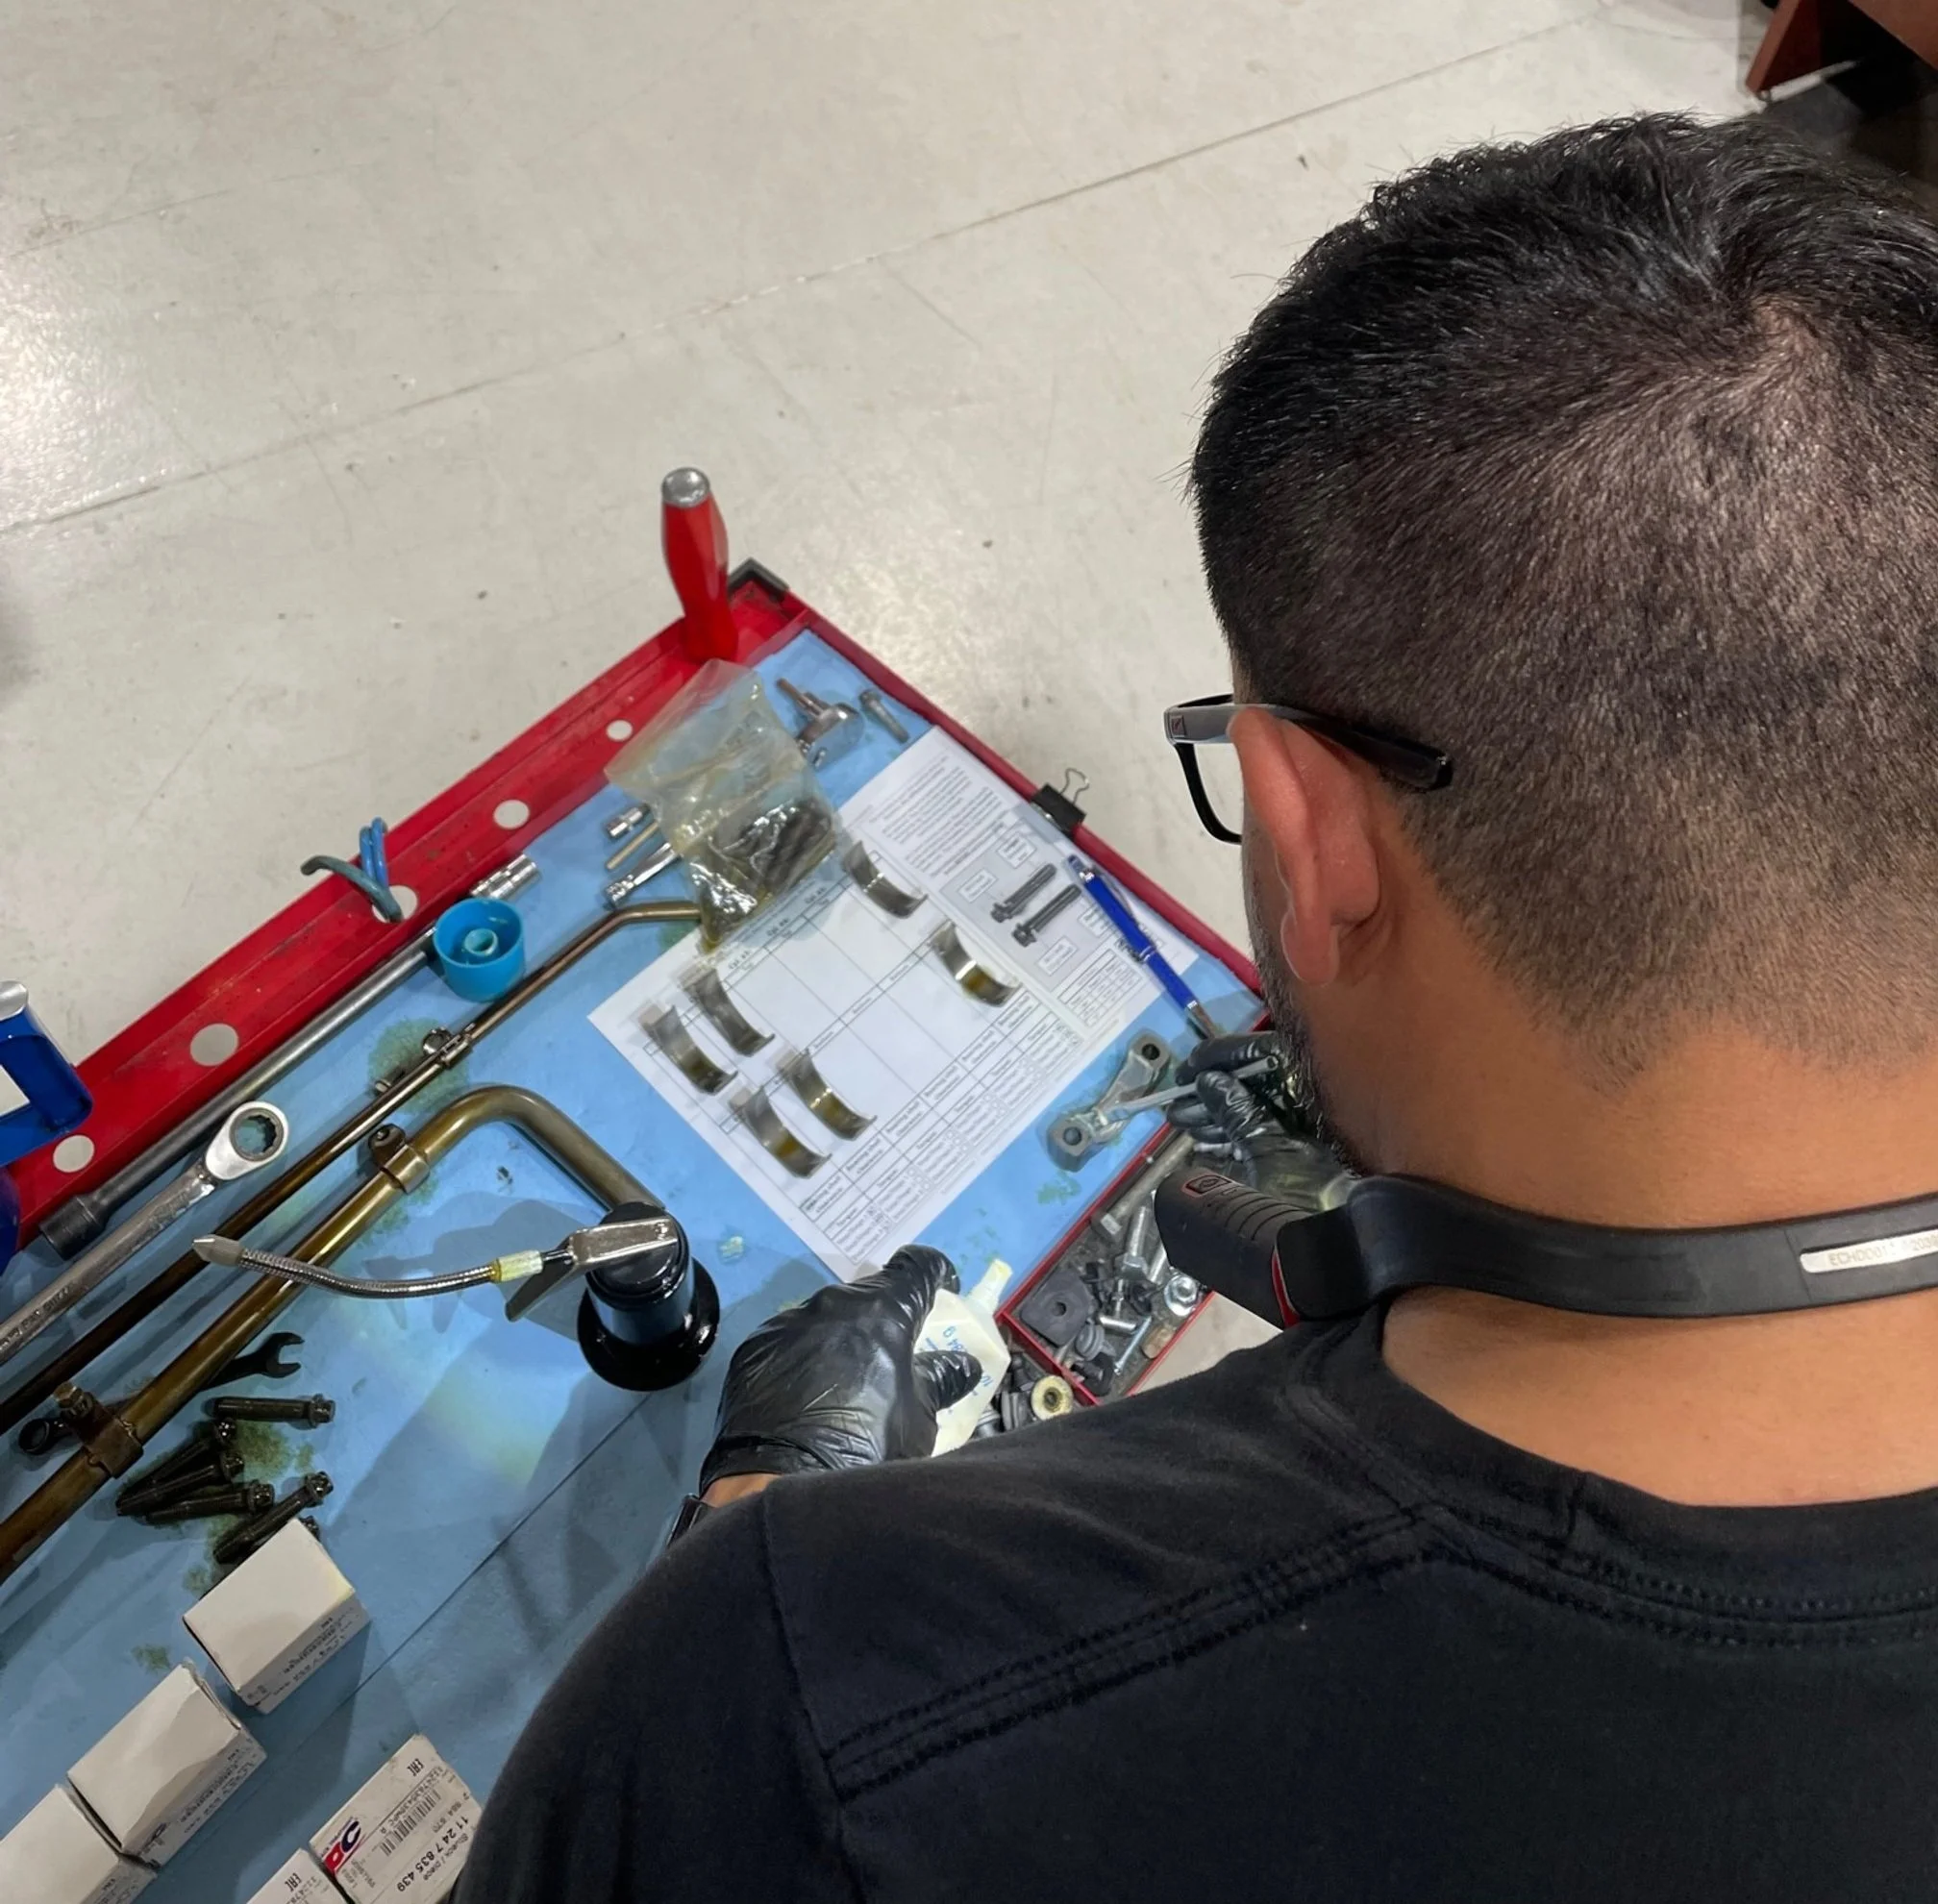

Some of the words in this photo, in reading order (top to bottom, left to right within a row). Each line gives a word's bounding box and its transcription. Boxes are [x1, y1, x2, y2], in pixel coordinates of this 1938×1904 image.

[455, 1815, 469, 1830] 11
[441, 1828, 458, 1844] 24
[435, 1841, 444, 1853] 7
[415, 1851, 435, 1871] 835
[397, 1871, 415, 1892] 439
